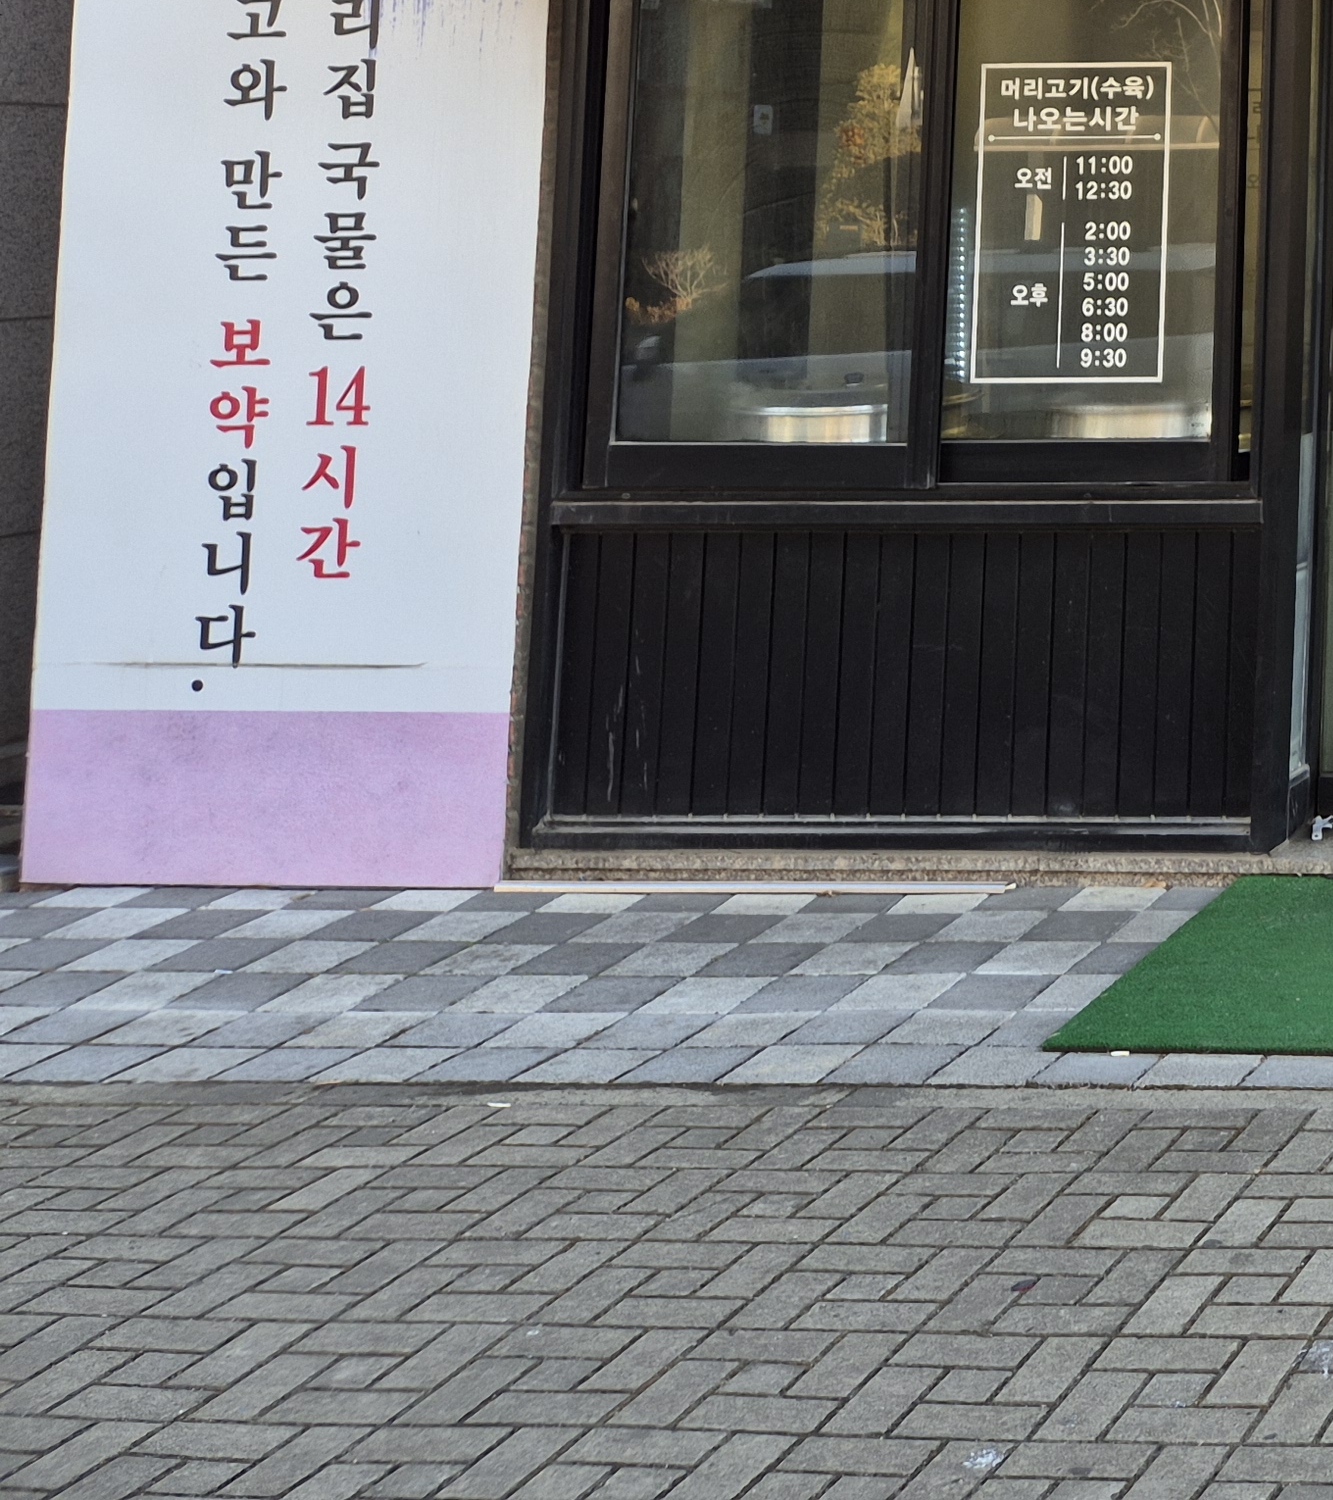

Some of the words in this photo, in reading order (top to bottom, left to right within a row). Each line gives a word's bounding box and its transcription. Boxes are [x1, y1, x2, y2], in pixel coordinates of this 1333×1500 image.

[1000, 75, 1155, 101] 머리고기(수육)
[1012, 105, 1140, 132] 나오는시간
[1014, 167, 1053, 190] 오전
[1075, 155, 1134, 175] 11:00
[1074, 180, 1133, 200] 12:30
[215, 150, 283, 282] 만든
[309, 141, 380, 341] 국물은
[1084, 221, 1132, 241] 2:00
[1083, 247, 1131, 266] 3:30
[1082, 272, 1130, 292] 5:00
[1009, 282, 1049, 308] 오후
[1081, 297, 1129, 317] 6:30
[1080, 322, 1128, 343] 8:00
[1079, 347, 1128, 368] 9:30
[296, 365, 371, 580] 14시간
